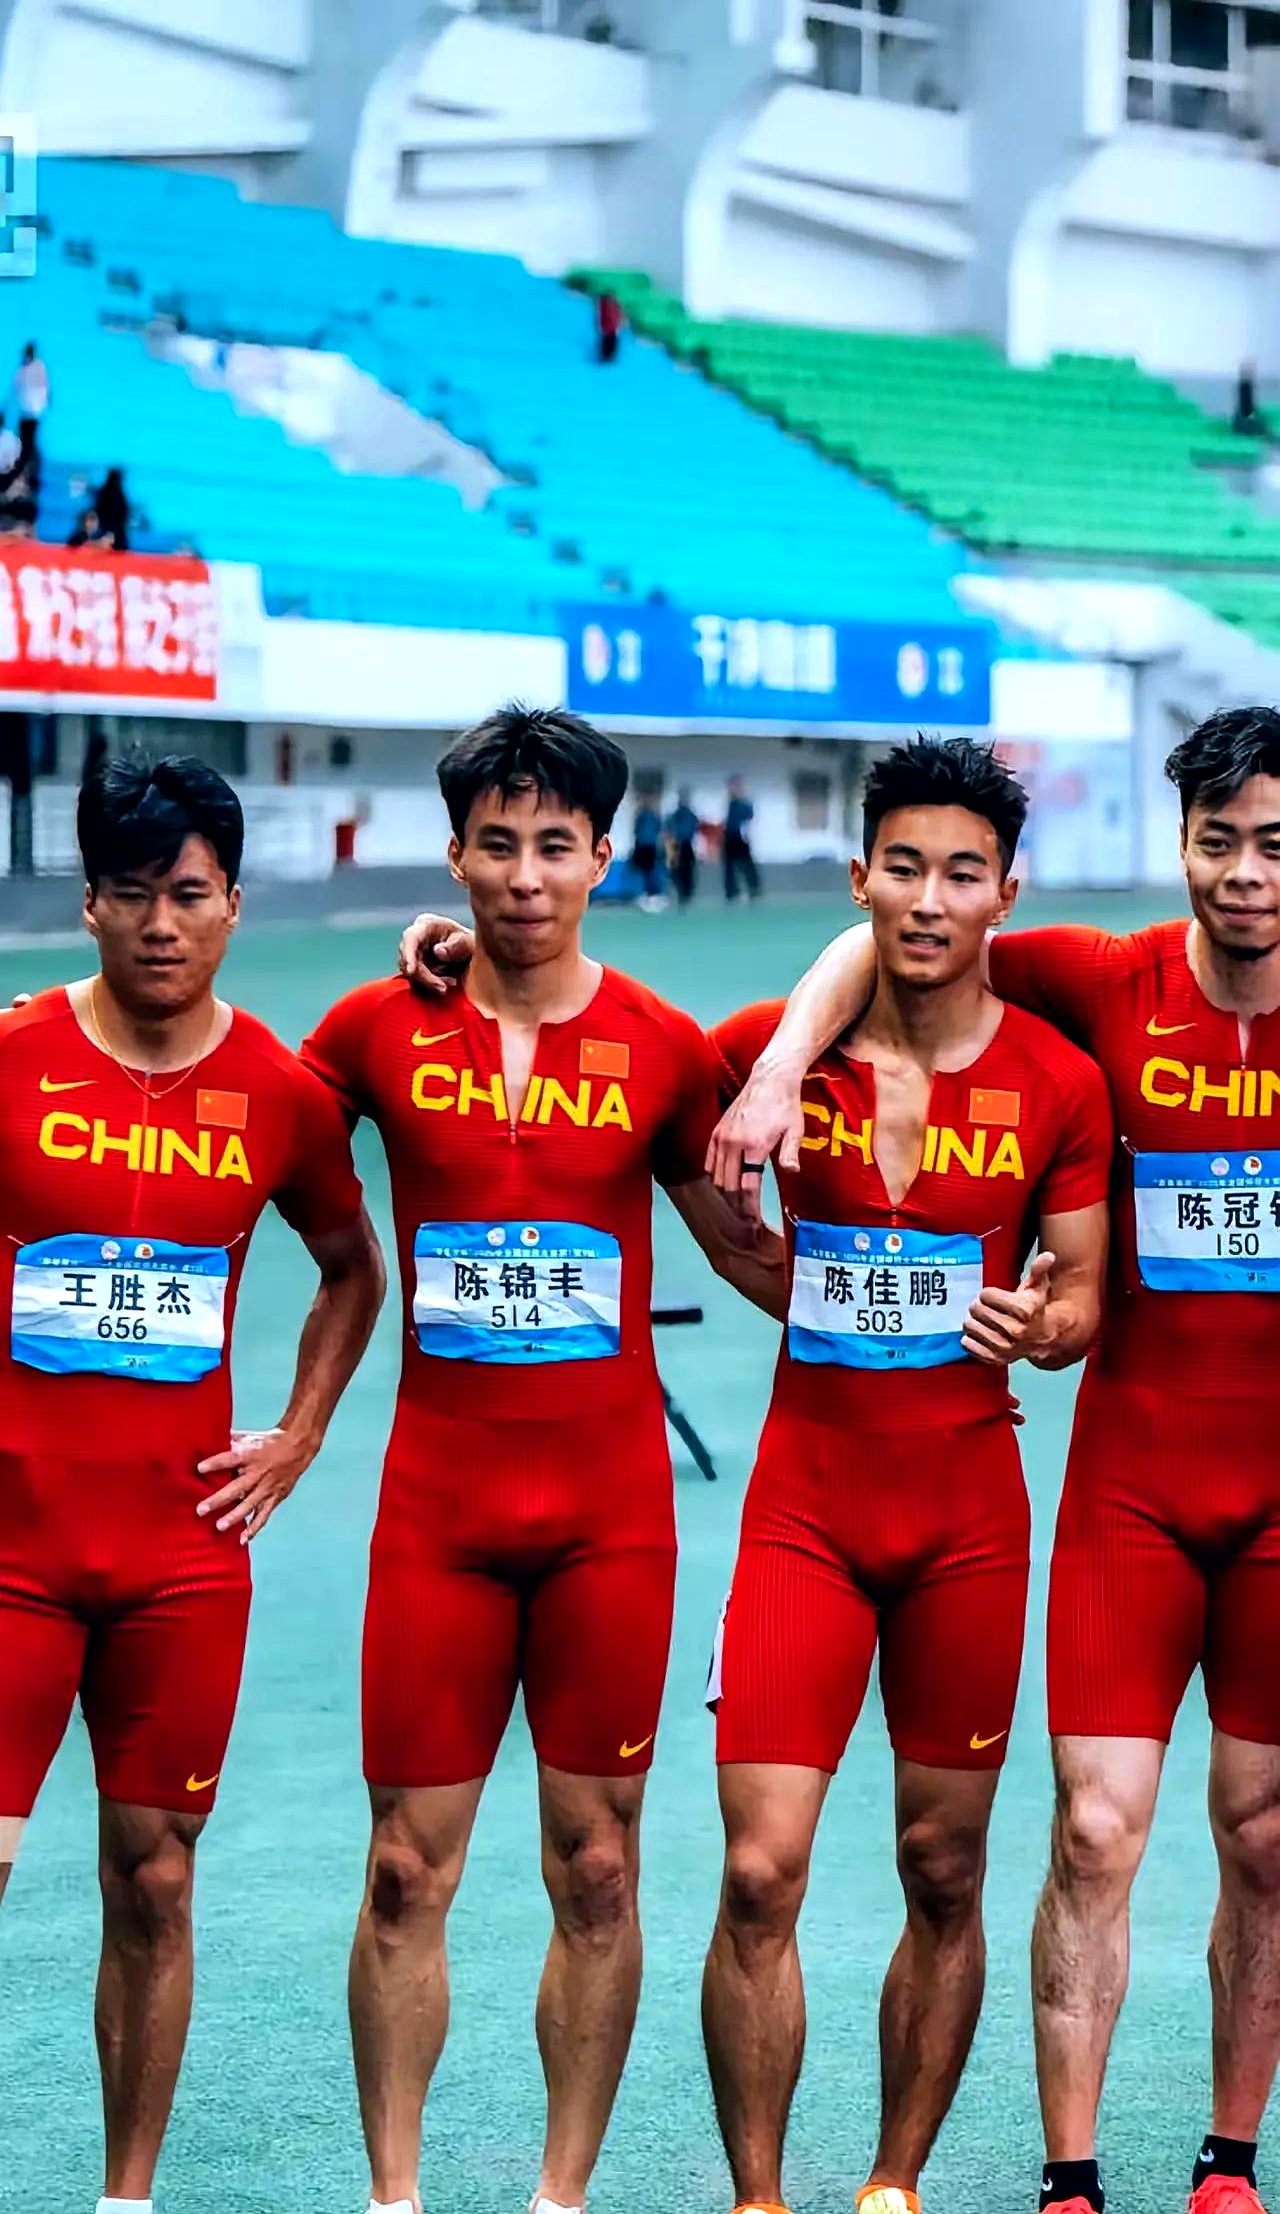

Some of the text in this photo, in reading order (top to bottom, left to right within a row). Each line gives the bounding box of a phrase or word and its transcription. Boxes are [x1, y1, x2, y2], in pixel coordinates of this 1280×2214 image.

[411, 1063, 633, 1132] CHINA
[39, 1111, 253, 1185] CHINA
[1217, 1233, 1260, 1256] 150
[59, 1273, 191, 1315] 王胜杰
[454, 1262, 584, 1301] 陈锦丰
[824, 1266, 948, 1306] 陈佳鹏
[97, 1315, 148, 1340] 656
[491, 1304, 542, 1328] 514
[856, 1309, 904, 1334] 503
